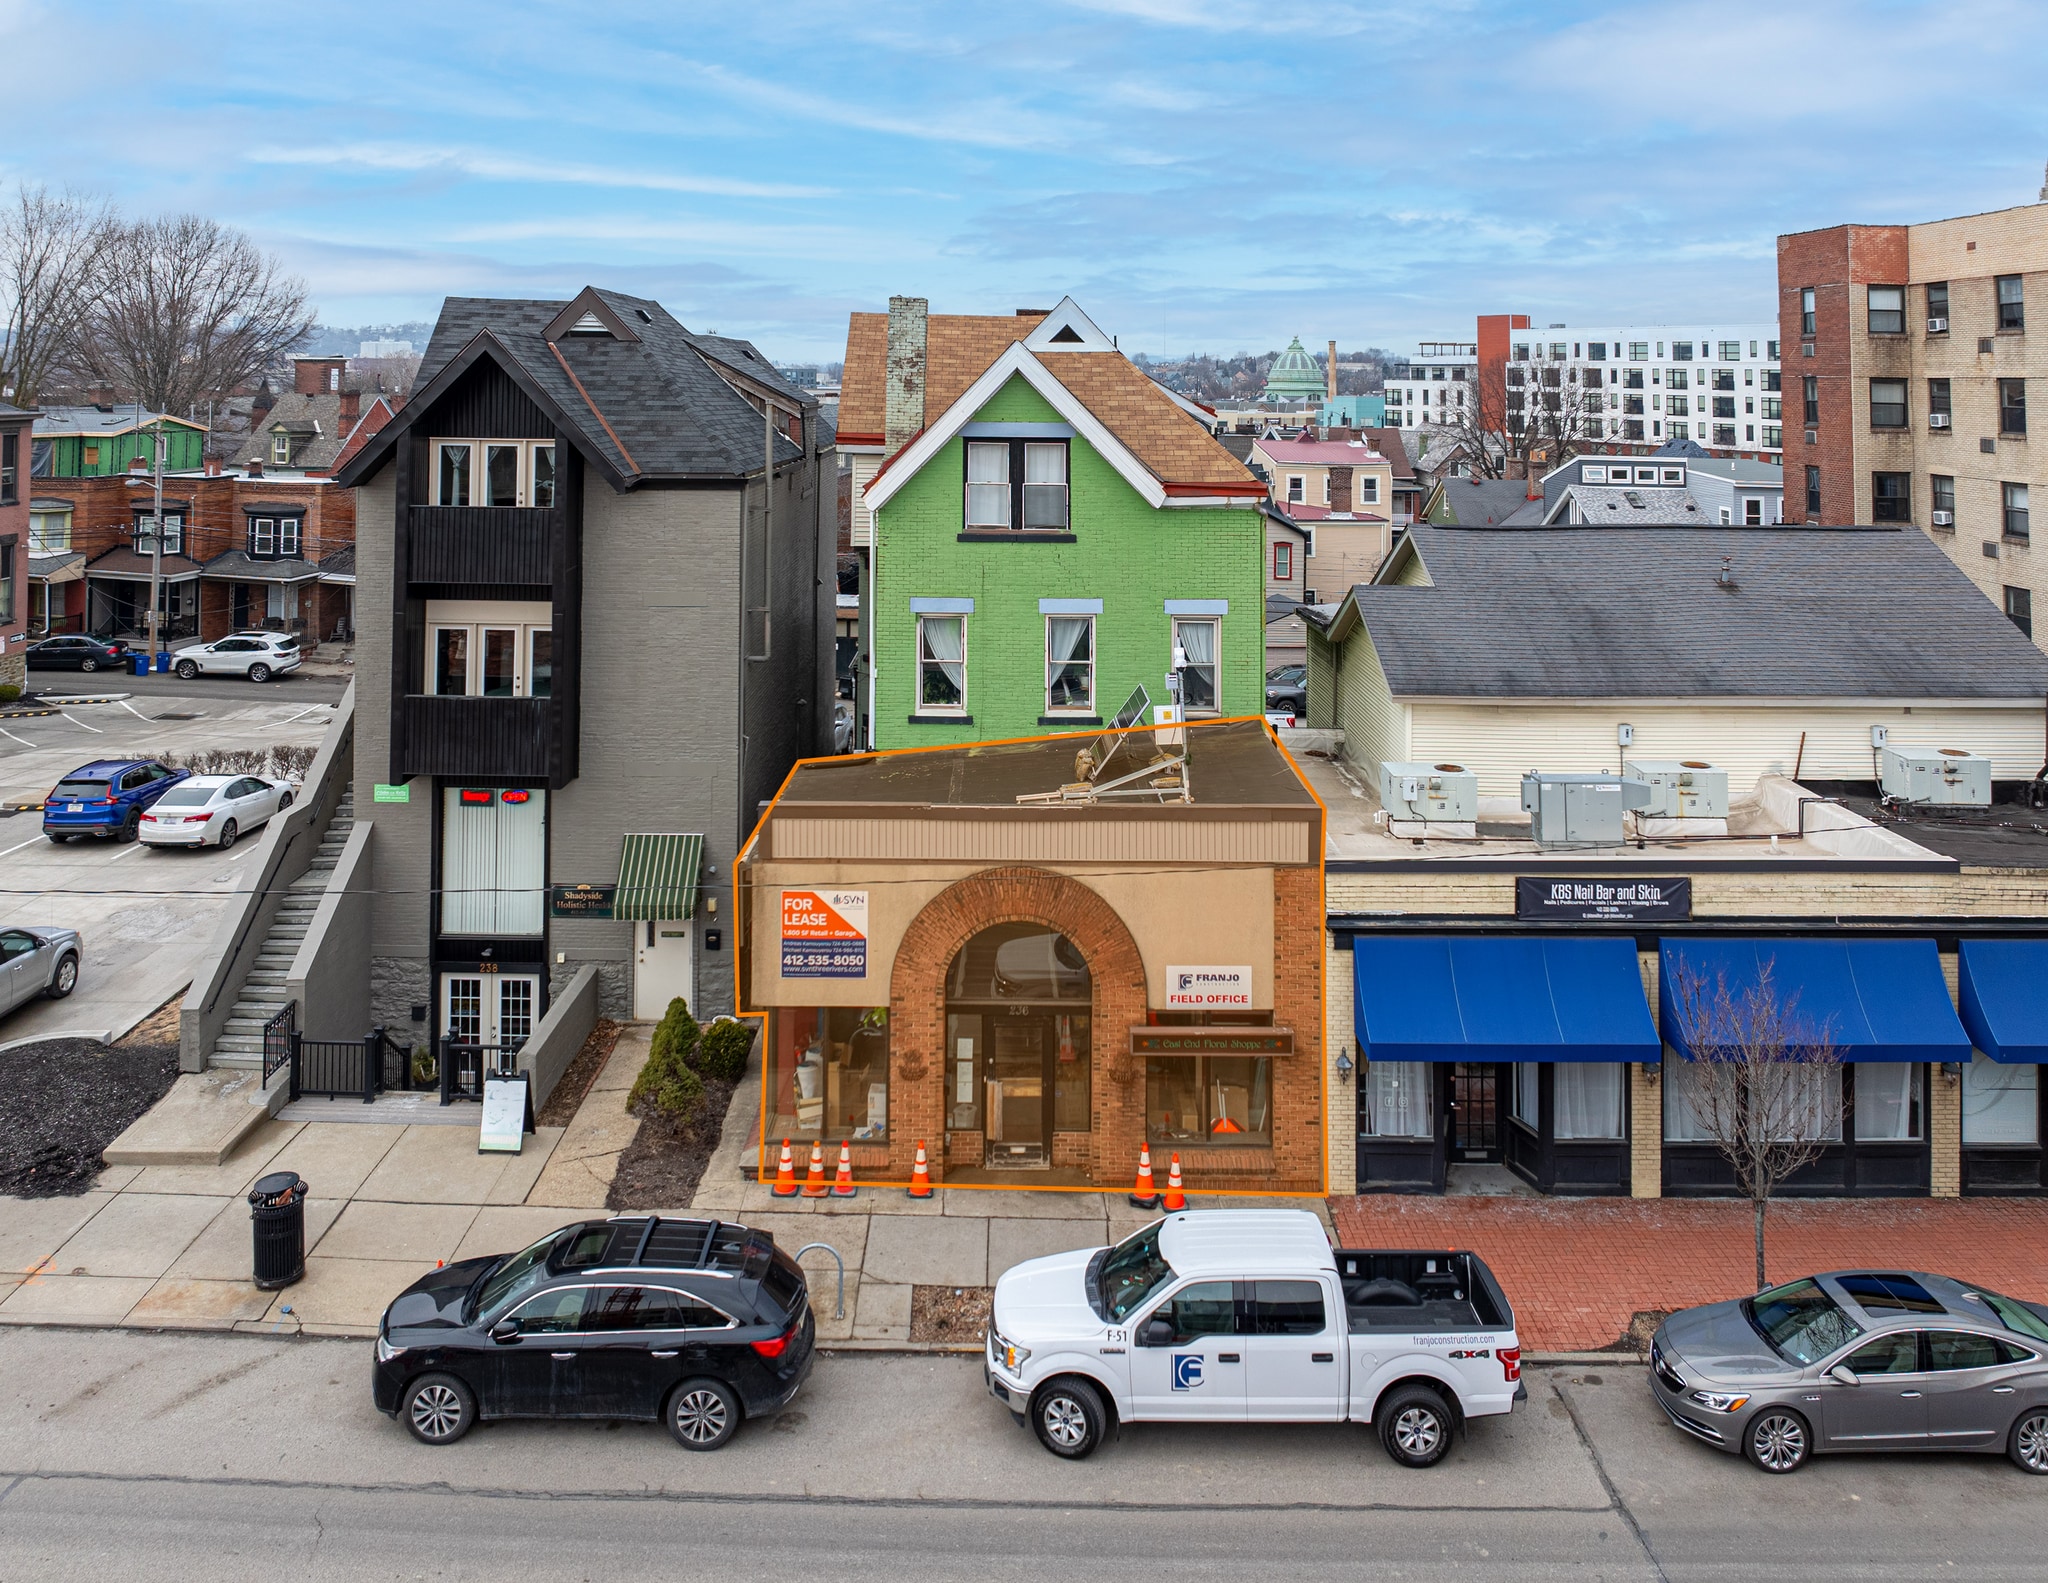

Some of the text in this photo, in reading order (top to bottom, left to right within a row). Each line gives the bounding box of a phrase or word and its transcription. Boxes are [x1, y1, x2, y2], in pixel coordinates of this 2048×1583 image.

[502, 790, 529, 801] OPEN
[564, 891, 603, 901] Shadyside
[1551, 884, 1660, 900] KBS Nail Bar and Skin
[556, 901, 586, 909] Holistic
[784, 898, 813, 911] FOR
[843, 895, 865, 905] SVN
[784, 913, 828, 926] LEASE
[834, 930, 857, 938] Garage
[783, 955, 865, 966] 412-535-8050
[479, 963, 498, 973] 238
[1196, 974, 1240, 982] FRANJO
[1170, 995, 1249, 1004] FIELD OFFICE
[1009, 1005, 1030, 1016] 236
[1162, 1039, 1261, 1050] East End Floral Shoppe
[1107, 1330, 1128, 1342] F-51
[1413, 1335, 1496, 1347] franjoconstruction.com
